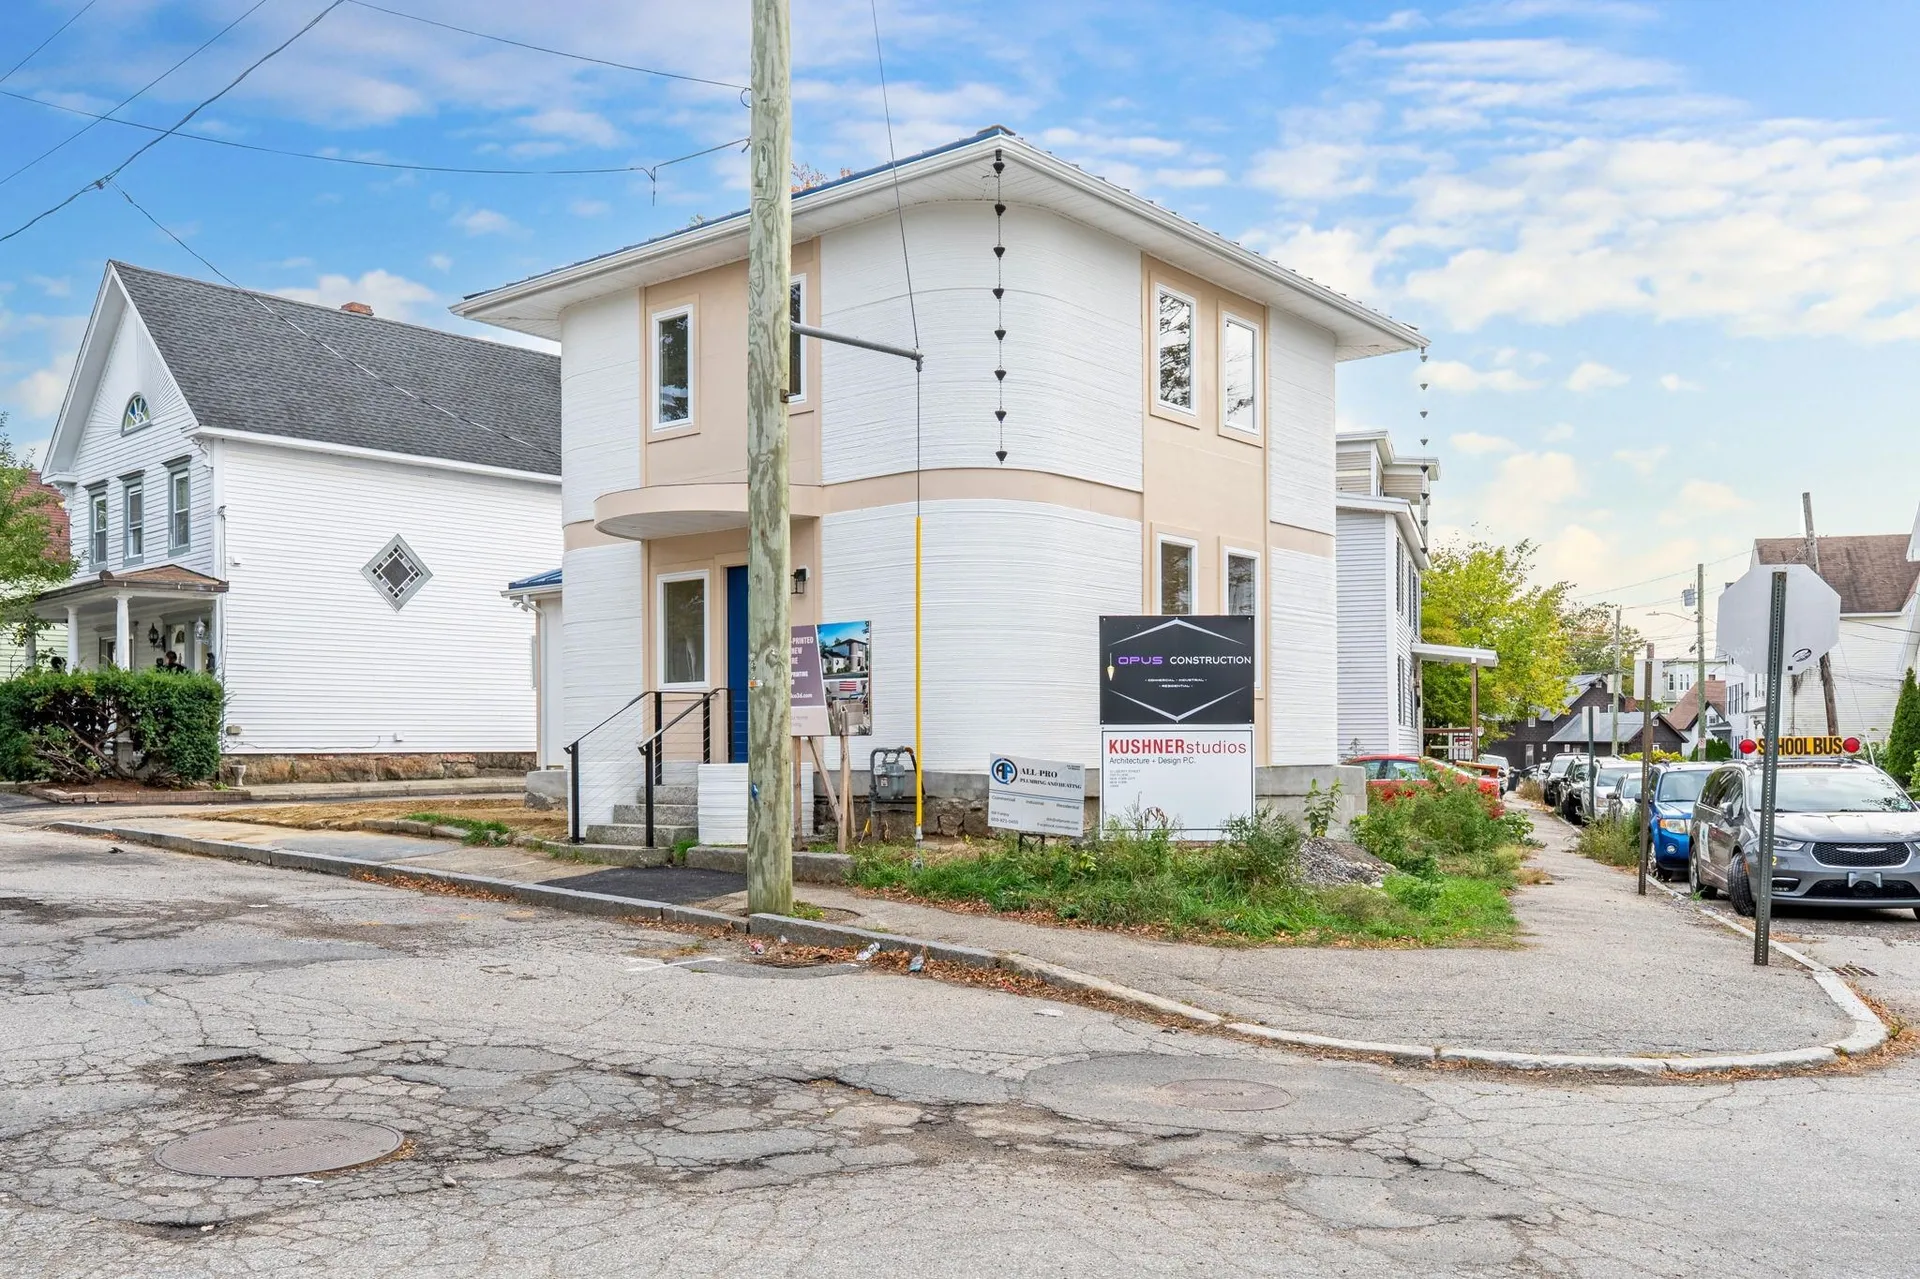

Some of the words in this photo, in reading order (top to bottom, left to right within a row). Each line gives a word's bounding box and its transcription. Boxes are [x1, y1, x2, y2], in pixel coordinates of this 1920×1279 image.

[791, 636, 814, 645] -PRINTED
[1117, 656, 1163, 665] OPUS
[1169, 656, 1252, 665] CONSTRUCTION
[1109, 739, 1247, 755] KUSHNERstudios
[1758, 738, 1812, 756] SHOOL
[1814, 737, 1843, 755] BUS
[1158, 757, 1181, 766] Design
[1020, 778, 1046, 786] PLUMBING
